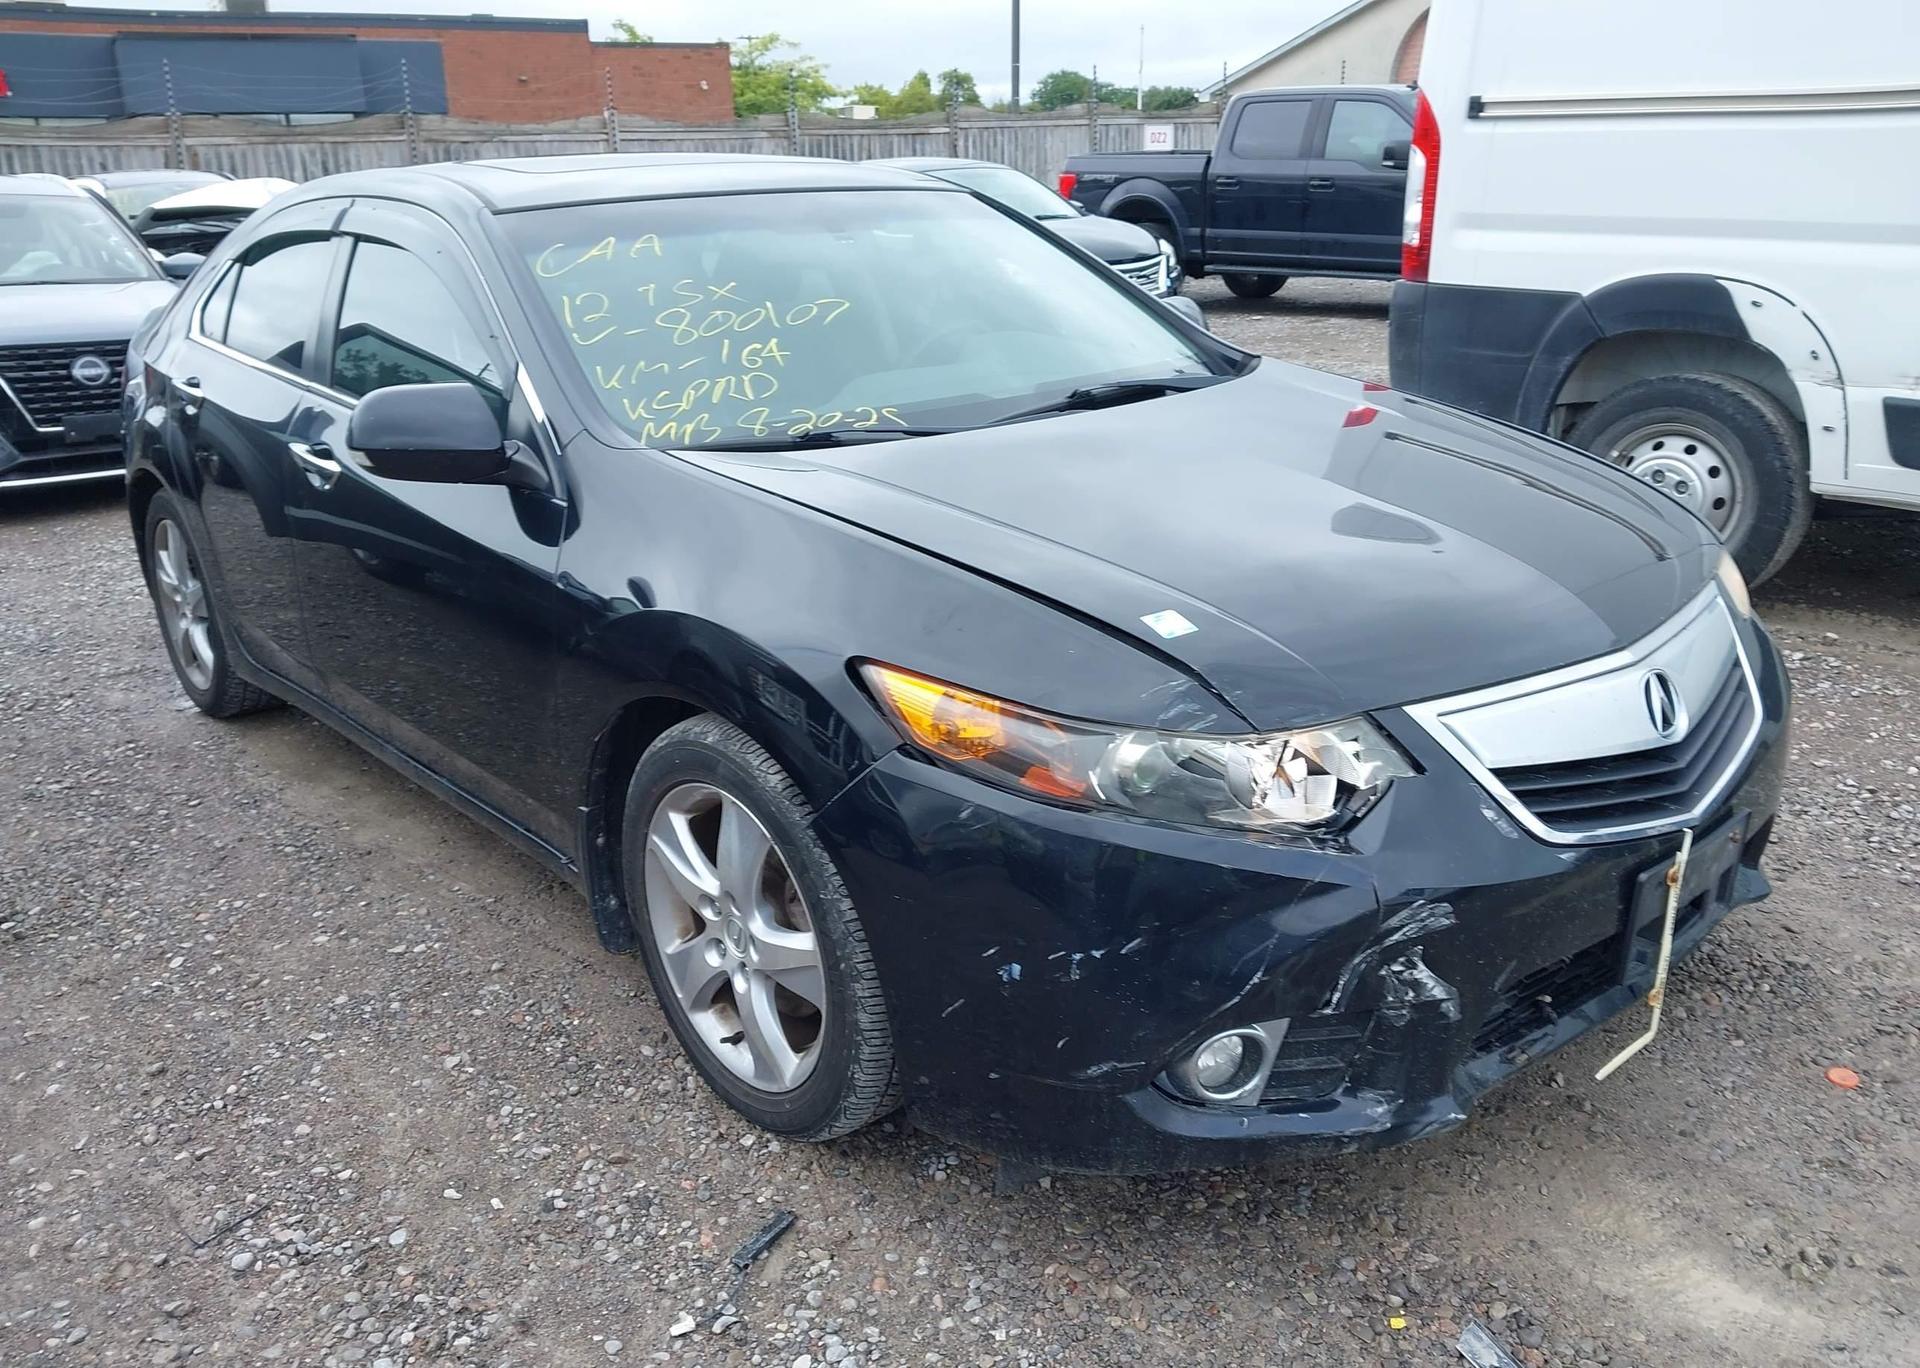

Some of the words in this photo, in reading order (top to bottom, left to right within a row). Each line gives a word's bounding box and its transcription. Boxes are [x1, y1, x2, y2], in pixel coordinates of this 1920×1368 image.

[535, 233, 662, 278] CAA
[562, 291, 612, 329] 12
[637, 279, 750, 308] TSX
